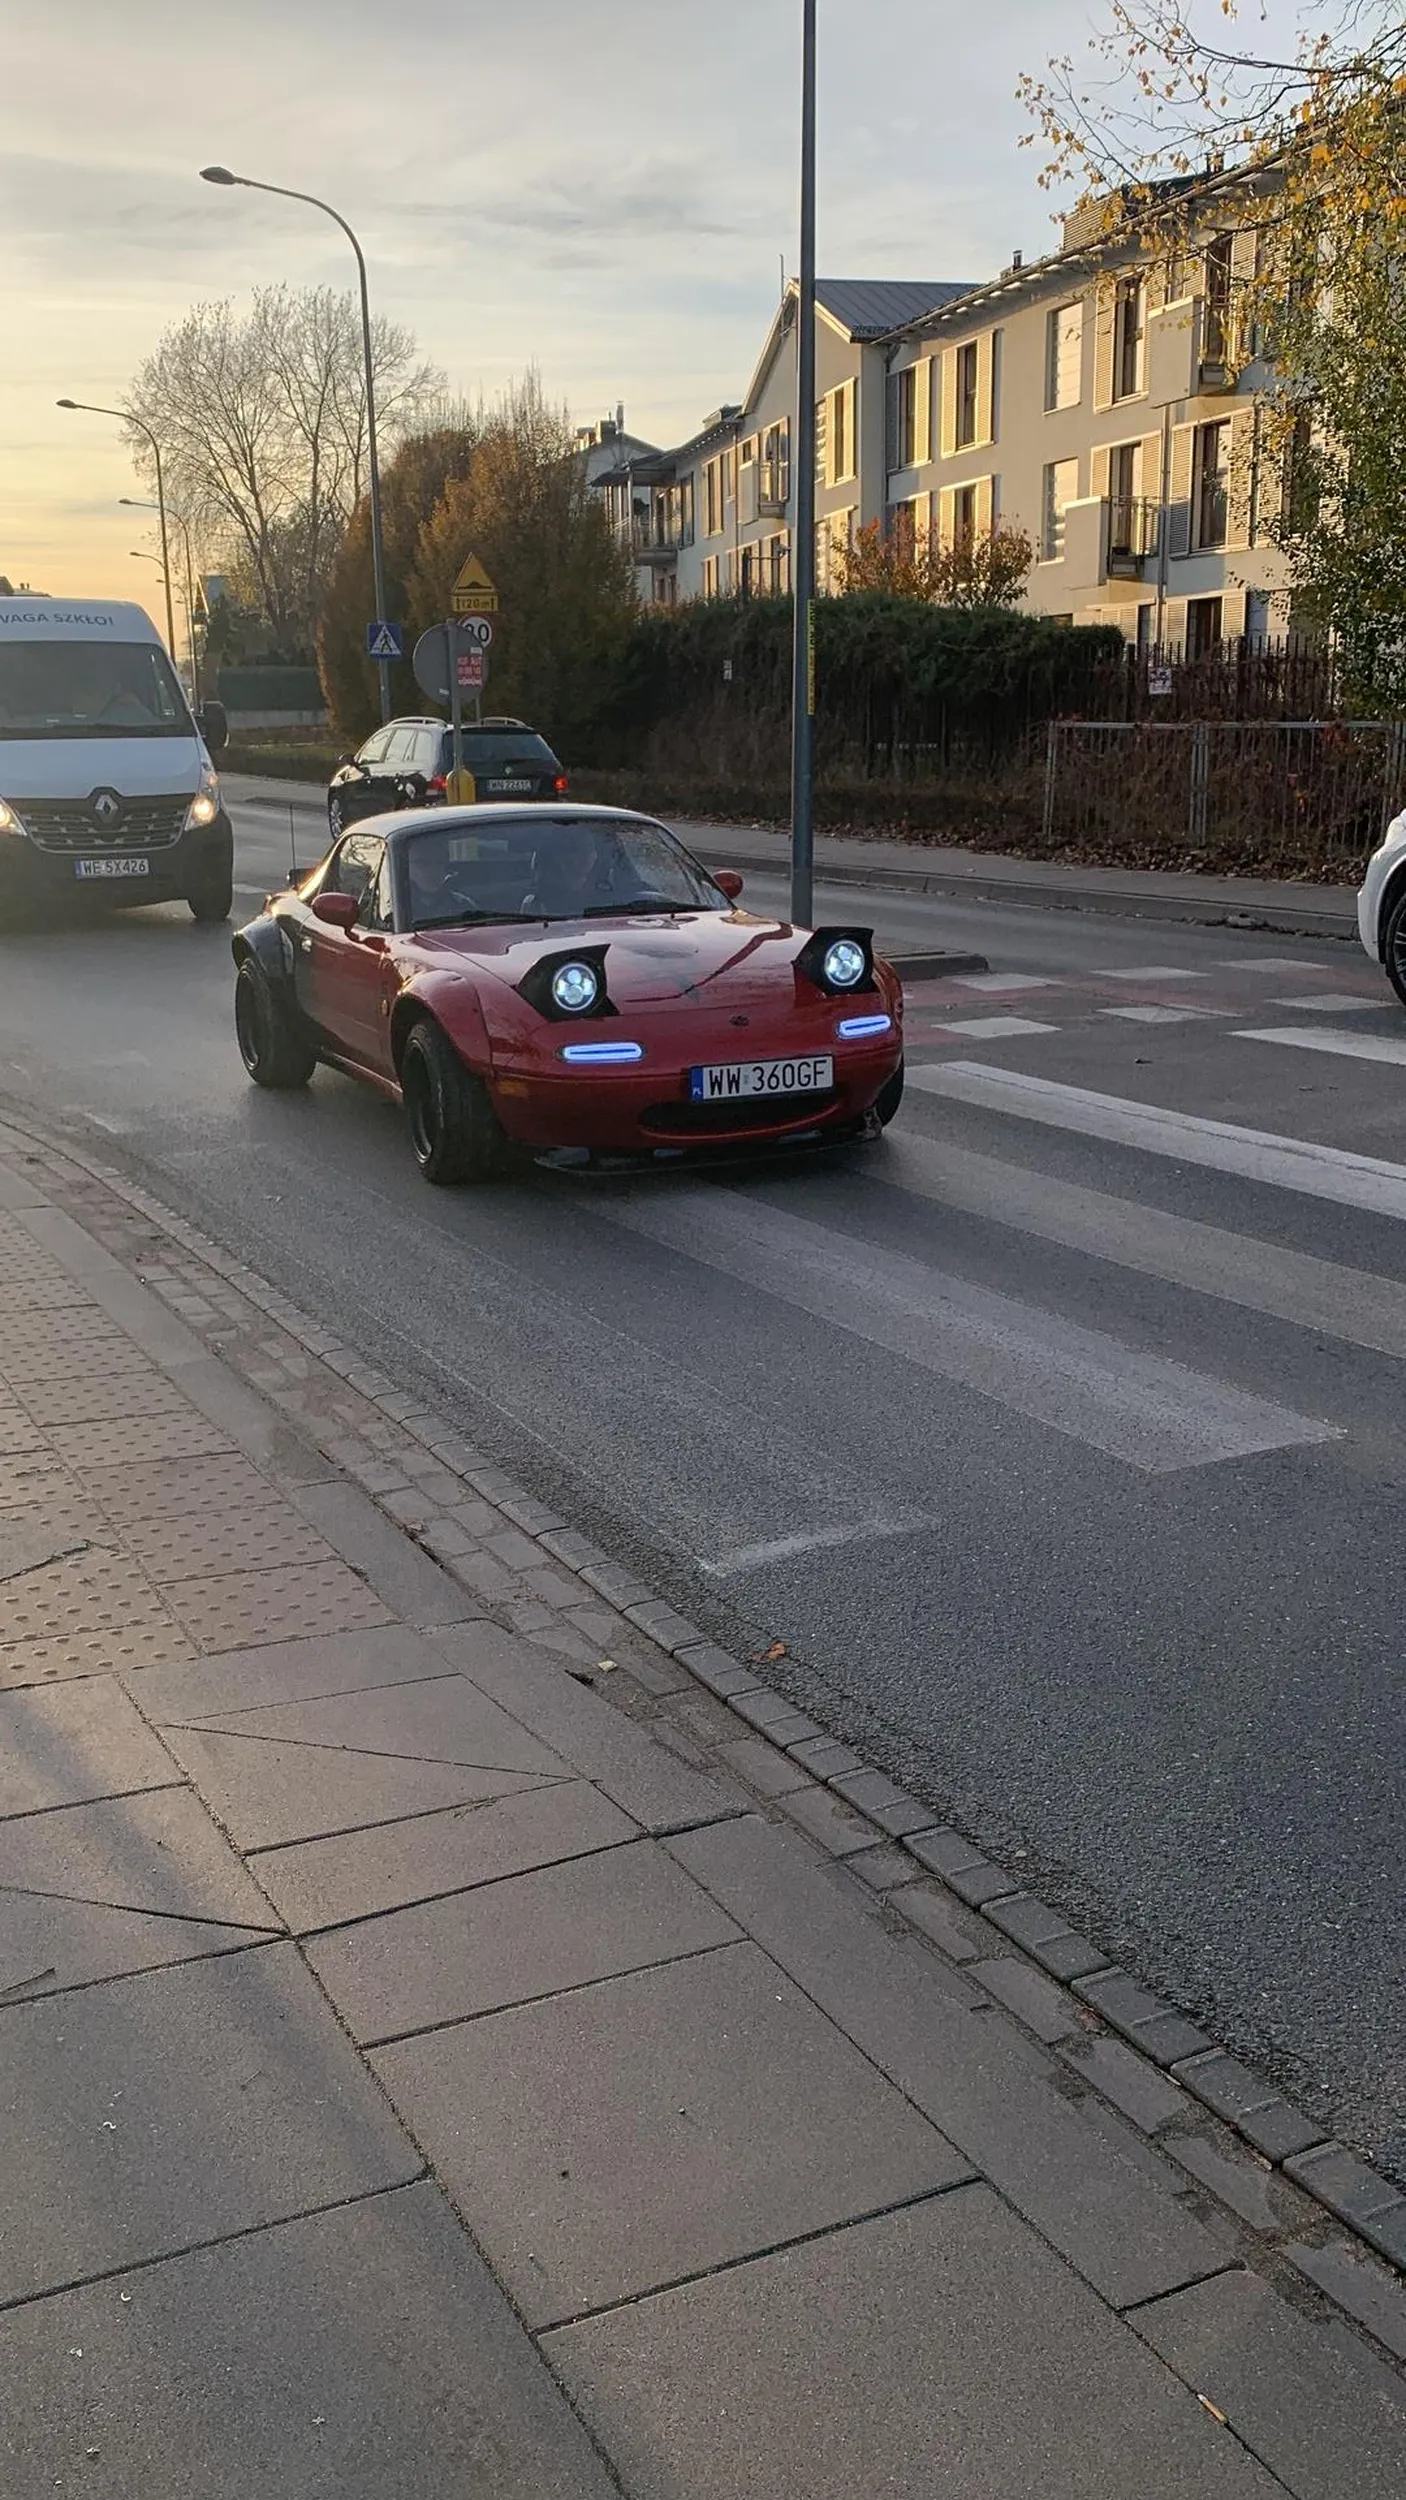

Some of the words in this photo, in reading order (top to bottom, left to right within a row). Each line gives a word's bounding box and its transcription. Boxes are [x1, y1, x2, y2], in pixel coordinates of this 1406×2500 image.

[53, 613, 115, 626] SZKŁO!
[83, 861, 100, 874] WE
[709, 1067, 741, 1096] WW
[752, 1059, 827, 1092] 360GF
